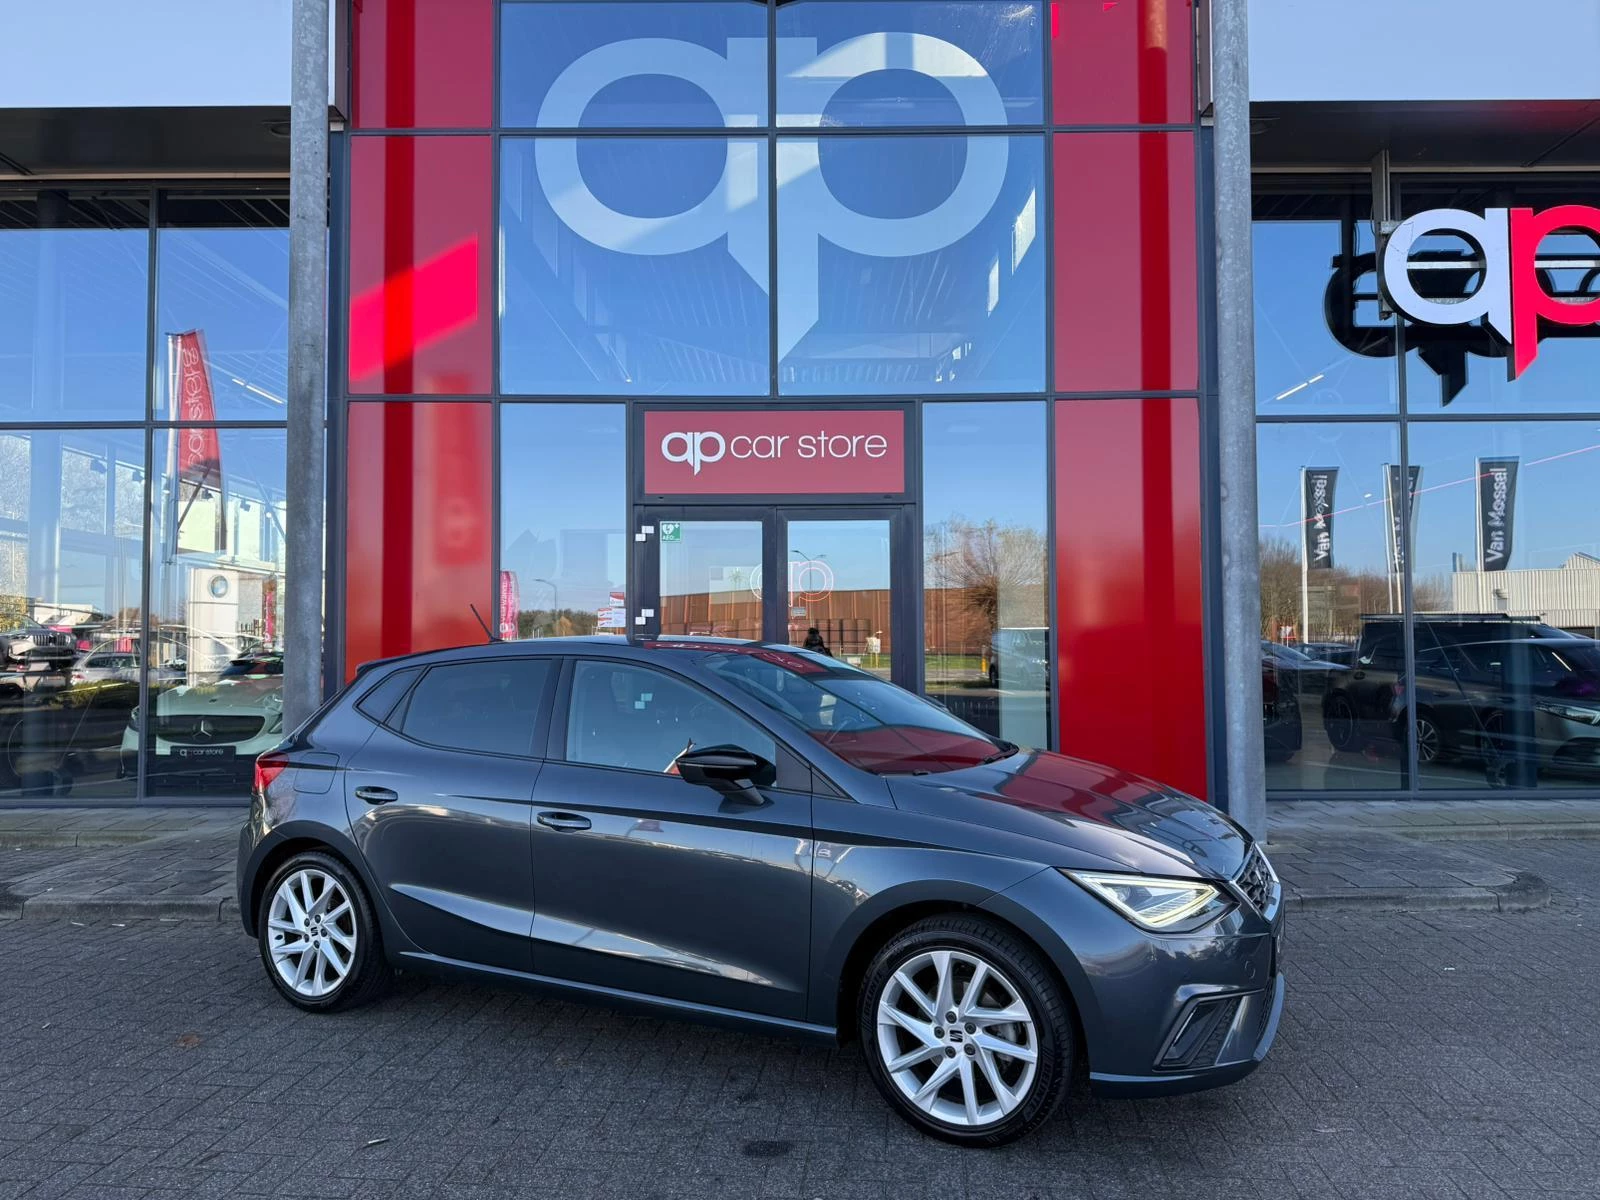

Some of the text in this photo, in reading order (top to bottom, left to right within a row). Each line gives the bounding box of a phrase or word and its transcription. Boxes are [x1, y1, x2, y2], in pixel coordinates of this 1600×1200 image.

[535, 32, 1008, 366] ap
[1384, 205, 1600, 380] ap
[661, 430, 888, 476] ap car store
[1313, 531, 1330, 561] Van
[1485, 468, 1507, 562] Van Mossel
